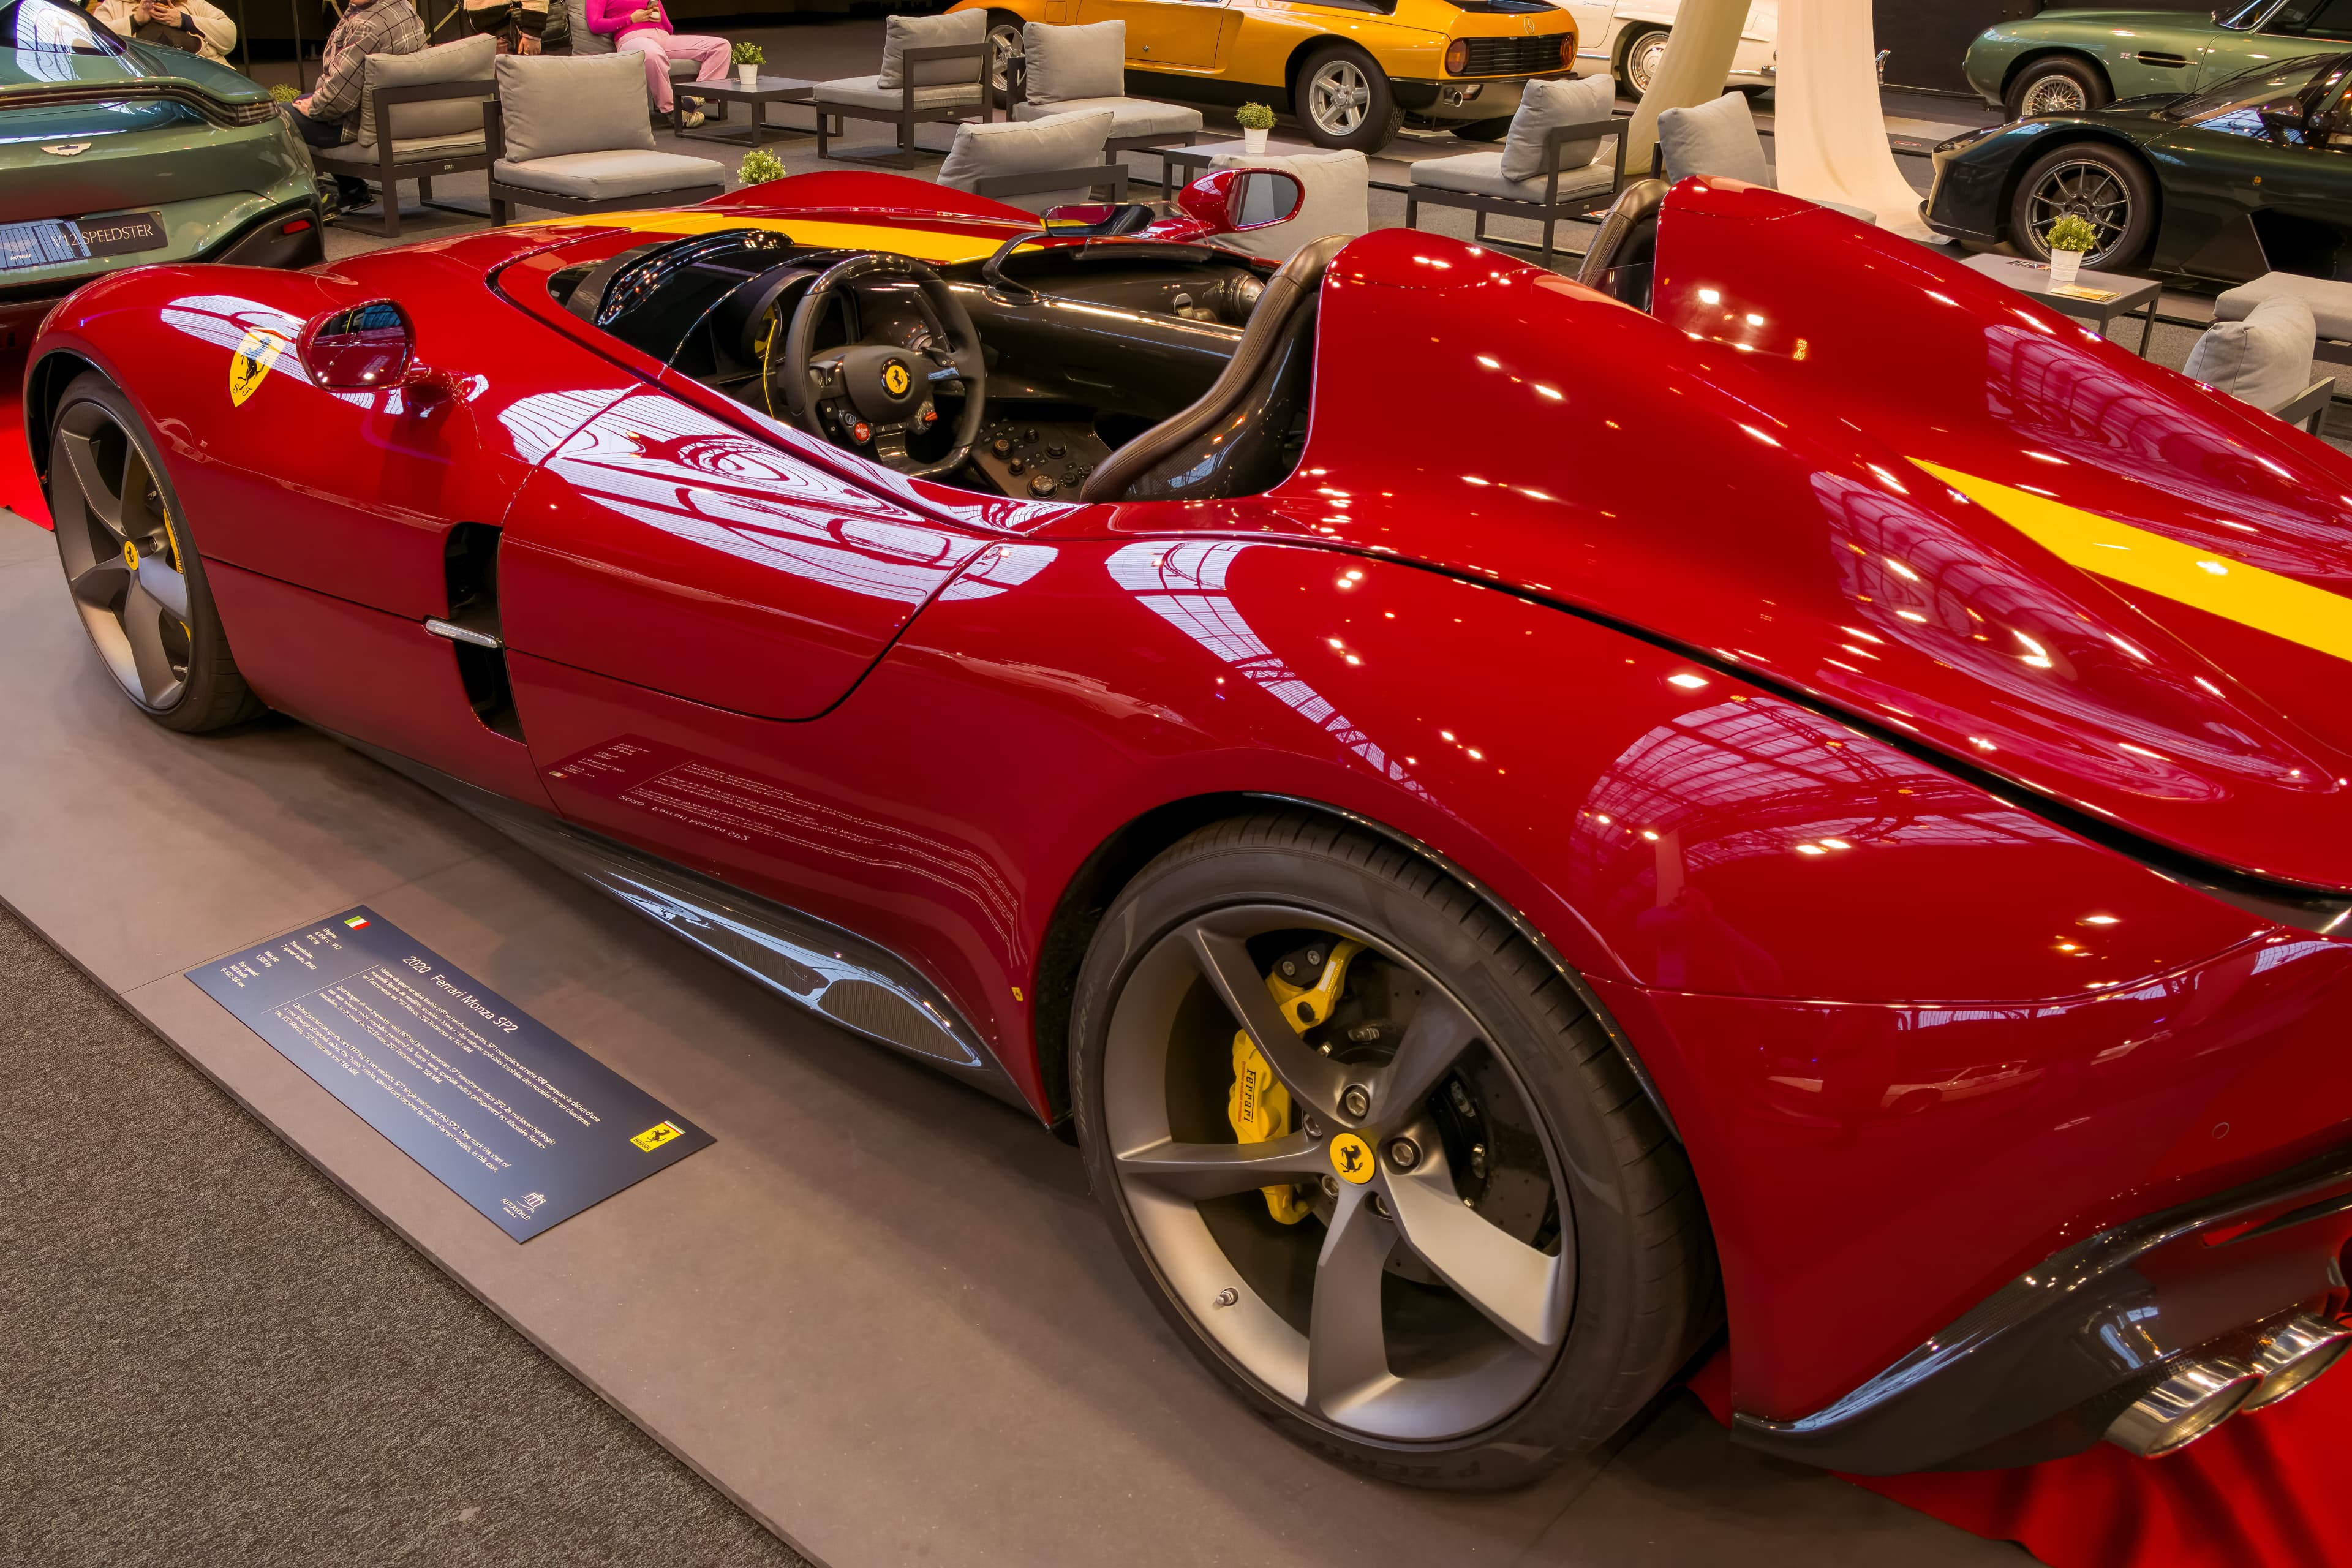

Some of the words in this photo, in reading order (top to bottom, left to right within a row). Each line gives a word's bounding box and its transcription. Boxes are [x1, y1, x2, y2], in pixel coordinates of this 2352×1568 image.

[51, 233, 78, 247] V12
[82, 224, 154, 244] SPEEDSTER
[233, 384, 239, 393] S
[323, 927, 337, 939] Engine:
[284, 946, 299, 956] speed
[304, 961, 317, 970] RWD
[402, 956, 431, 973] 2020
[430, 974, 467, 998] Ferrari
[461, 995, 495, 1019] Monza
[492, 1017, 518, 1033] SP2
[380, 967, 394, 979] Voiture
[397, 981, 410, 990] sport
[524, 1069, 537, 1079] cette
[535, 1076, 548, 1085] SP2
[545, 1084, 568, 1100] marquant
[571, 1101, 587, 1114] début
[584, 1111, 600, 1122] d'une
[423, 1068, 433, 1077] 166
[466, 1038, 484, 1052] voitures
[482, 1050, 503, 1065] spéciales
[502, 1063, 523, 1079] inspirées
[530, 1084, 551, 1099] modèles
[549, 1096, 569, 1109] Ferrari
[565, 1108, 590, 1127] classiques,
[1243, 1068, 1256, 1123] Ferrari
[507, 1119, 528, 1136] klassieke
[510, 1112, 533, 1129] markeren
[532, 1126, 543, 1136] het
[540, 1133, 555, 1145] begin
[438, 1125, 458, 1138] Ferrari
[477, 1154, 489, 1163] this
[454, 1129, 471, 1140] They
[466, 1138, 484, 1149] mark
[480, 1147, 491, 1157] the
